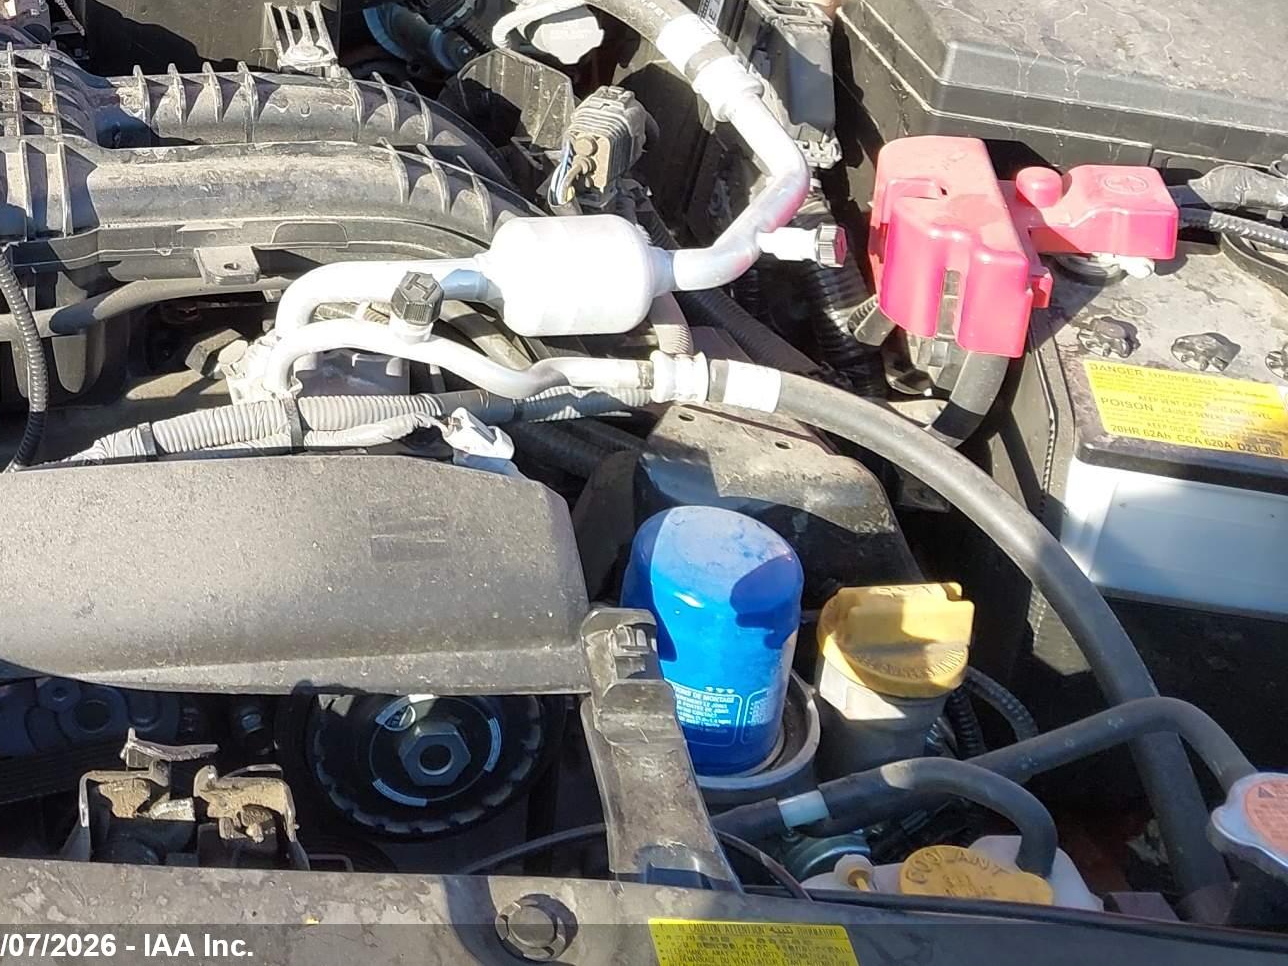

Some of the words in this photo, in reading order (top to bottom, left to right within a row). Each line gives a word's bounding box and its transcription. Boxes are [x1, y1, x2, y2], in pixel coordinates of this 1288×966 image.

[1089, 362, 1145, 378] DANGER
[1101, 396, 1155, 412] POISON
[1176, 434, 1203, 445] CCA
[1204, 437, 1233, 450] 620A
[905, 849, 1011, 885] COOLANT
